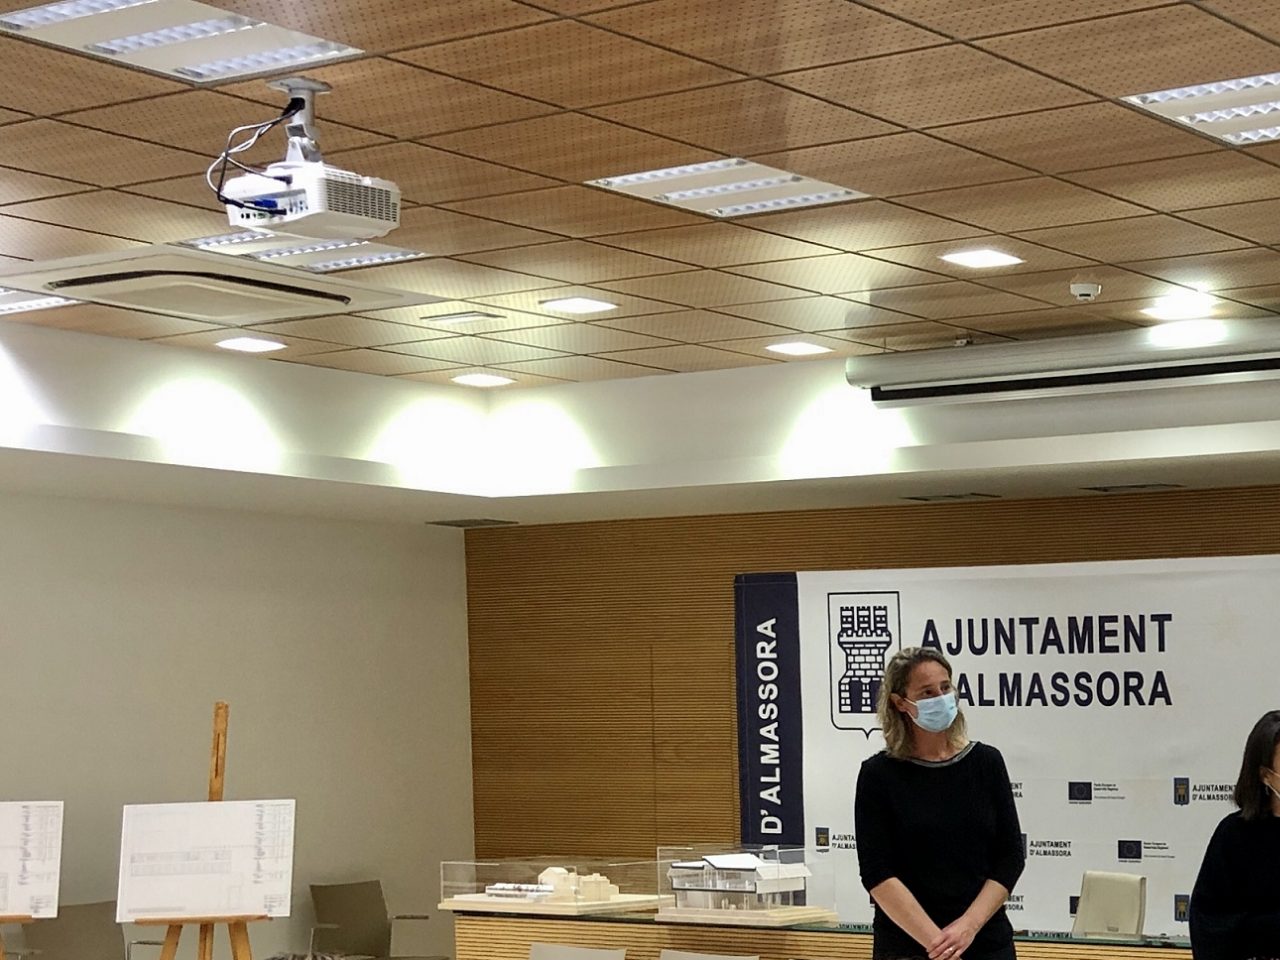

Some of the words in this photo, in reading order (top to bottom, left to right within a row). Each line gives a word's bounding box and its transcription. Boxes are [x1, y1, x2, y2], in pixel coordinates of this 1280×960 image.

[921, 613, 1172, 656] AJUNTAMENT
[957, 671, 1173, 707] ALMASSORA
[756, 617, 783, 835] D'ALMASSORA
[1192, 793, 1234, 801] D'ALMASSOR
[832, 834, 856, 842] AJUNTA
[1029, 840, 1072, 848] AJUNTAMENT
[1029, 849, 1072, 857] D'ALMASSORA
